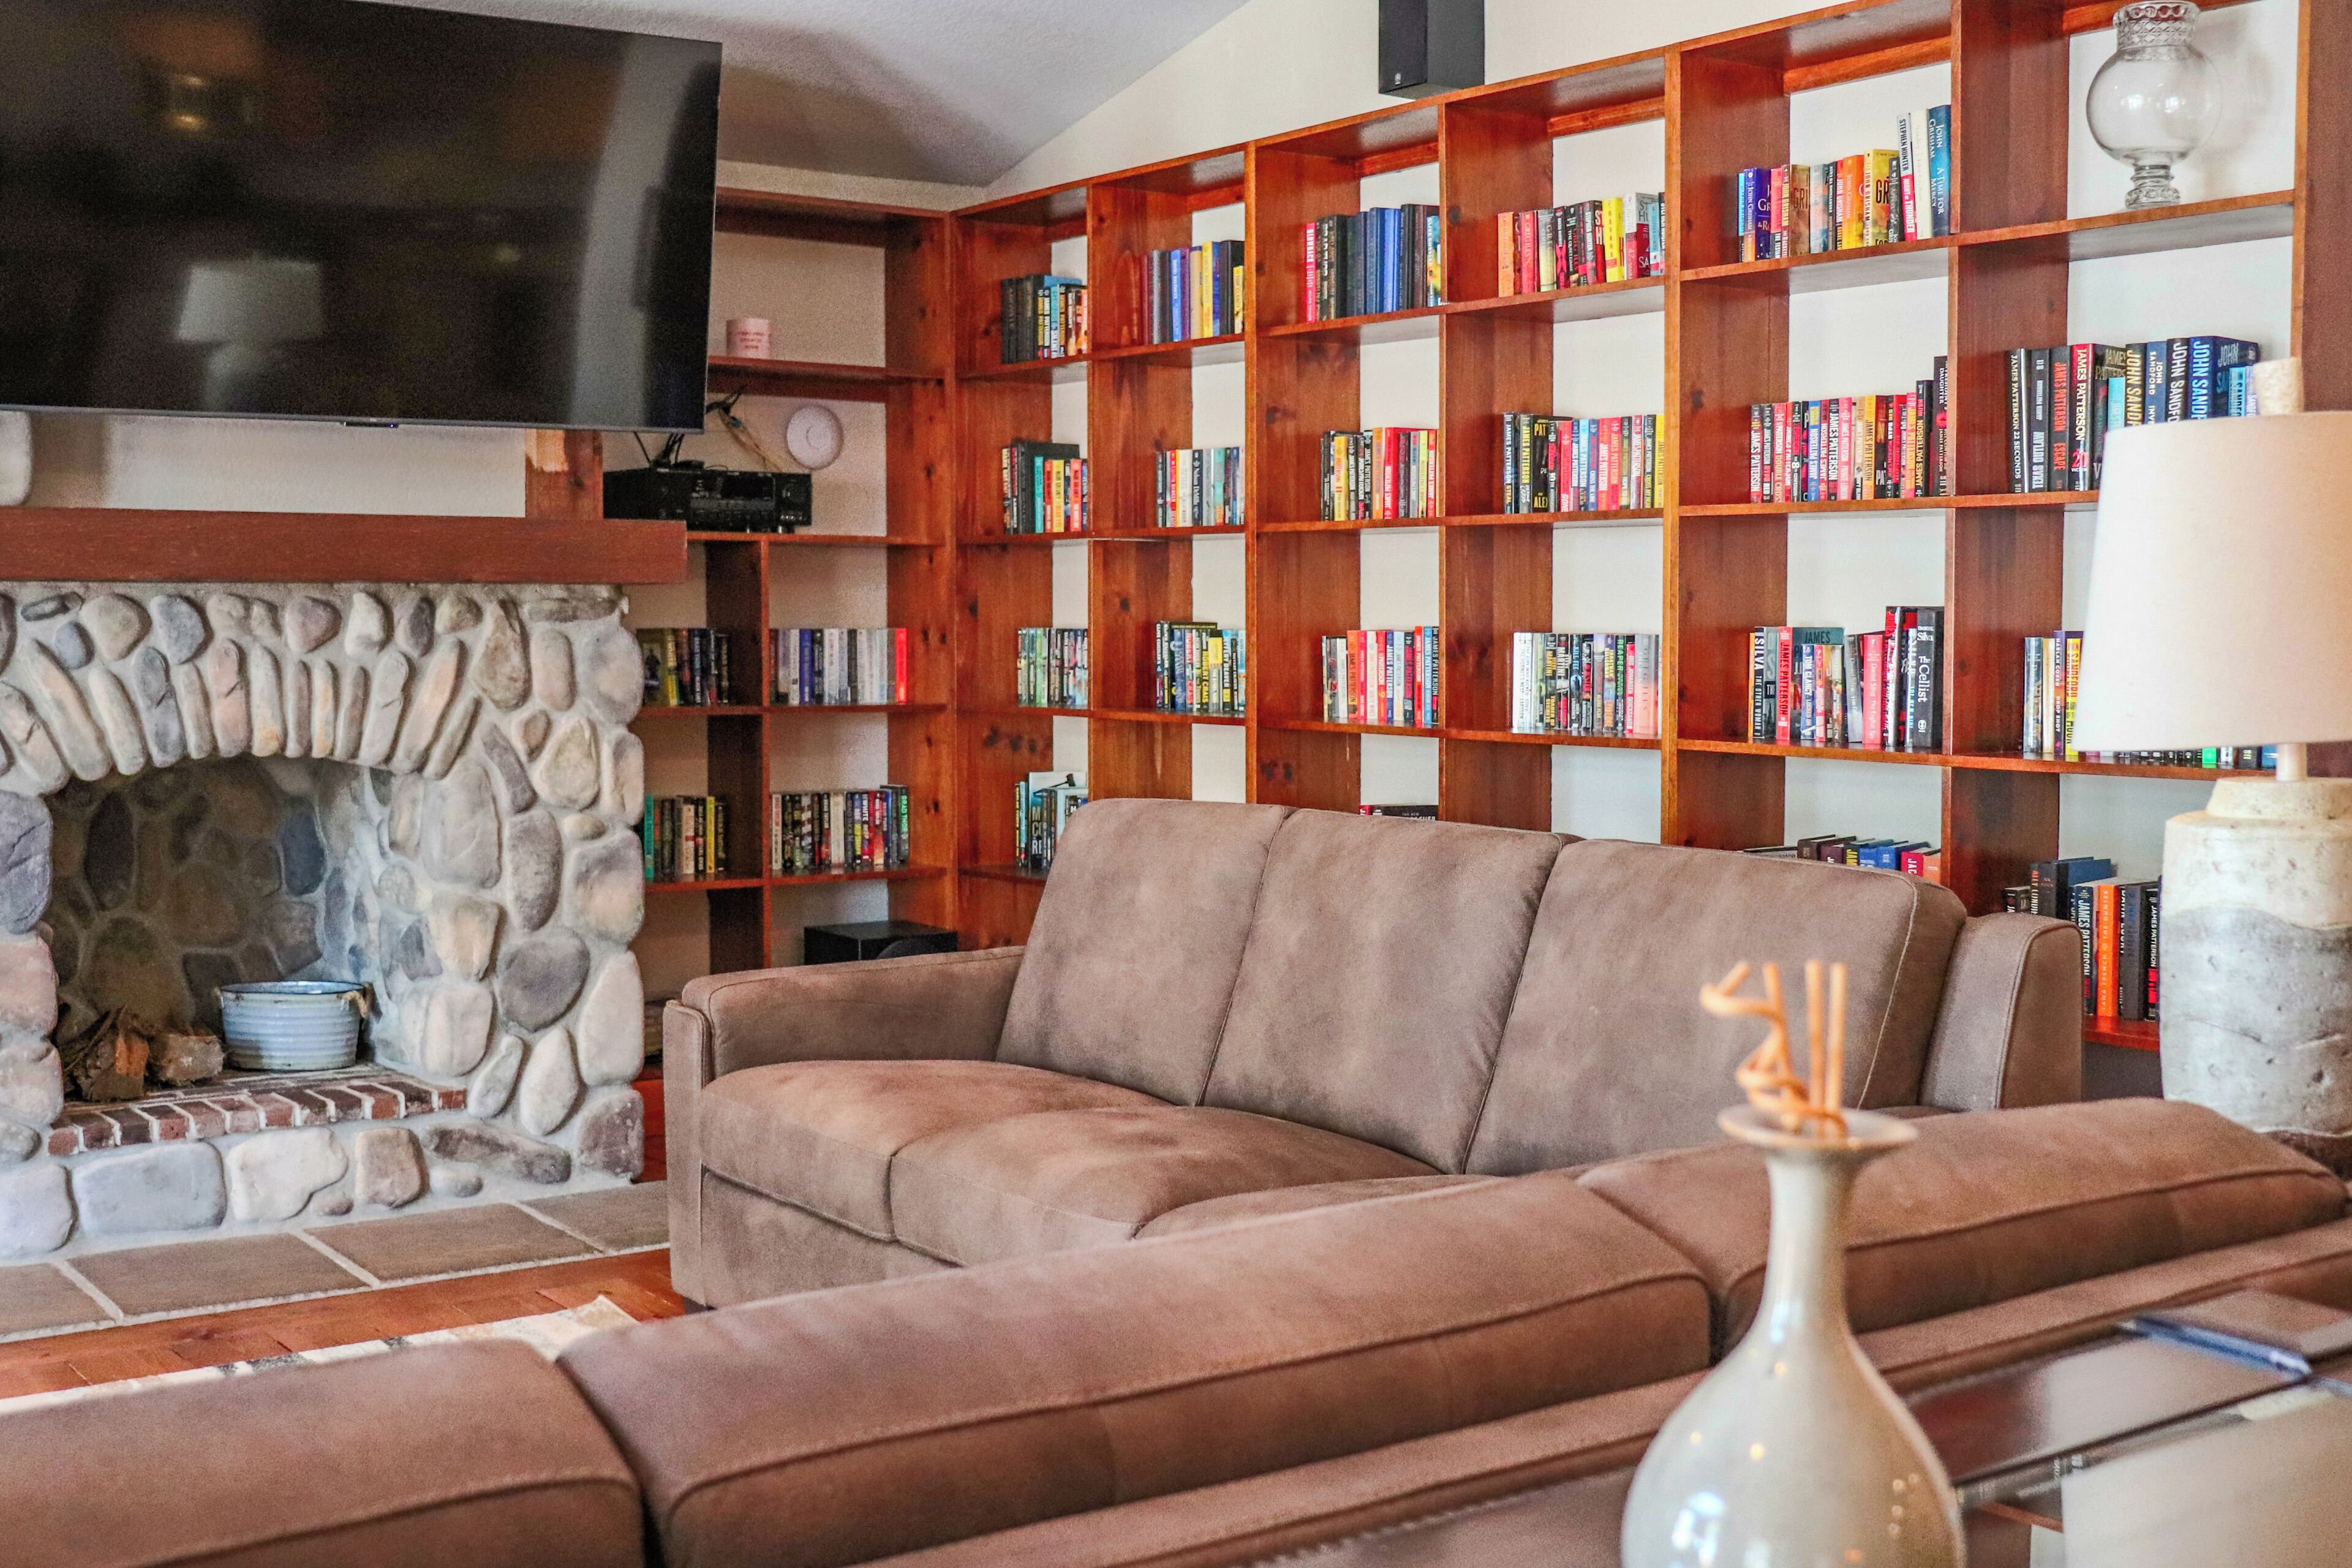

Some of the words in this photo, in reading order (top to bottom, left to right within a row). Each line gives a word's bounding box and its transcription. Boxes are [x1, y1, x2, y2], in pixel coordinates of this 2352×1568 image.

[1905, 200, 1915, 233] THUNDER
[2076, 349, 2087, 381] JAMES
[2126, 350, 2143, 385] JOHN
[2171, 342, 2188, 377] JOHN
[2192, 341, 2210, 377] JOHN
[2053, 362, 2066, 387] JAMES
[1829, 412, 1839, 437] JAMES
[1907, 407, 1916, 430] JAMES
[2053, 389, 2066, 431] PATTERSON
[2075, 382, 2086, 441] PATTERSON
[1751, 430, 1760, 453] JAMES
[1841, 421, 1850, 437] JAMES
[1864, 420, 1874, 442] JAMES
[2013, 431, 2020, 440] 22
[1599, 443, 1608, 461] JAMES
[1809, 429, 1818, 460] PATTERSON
[1828, 438, 1839, 480] PATTERSON
[1907, 431, 1916, 470] PATTERSON
[2032, 431, 2044, 463] OUTLAW
[2053, 442, 2066, 471] ESCAPE
[1599, 462, 1608, 491] PATTERSON
[1751, 455, 1760, 491] PATTERSON
[1809, 461, 1818, 480] JAMES
[1864, 443, 1873, 481] PATTERSON
[2032, 465, 2044, 489] TEXAS
[1804, 631, 1831, 644] JAMES
[1917, 632, 1934, 642] Silva
[1557, 646, 1566, 676] MARTINI
[1754, 638, 1764, 670] SILVA
[1780, 642, 1790, 668] JAMES
[1918, 655, 1931, 664] The
[1804, 671, 1812, 696] CLANCY
[1918, 664, 1930, 703] Cellist
[2066, 653, 2079, 698] SANDFORD
[1779, 671, 1789, 715] PATTERSON
[2078, 899, 2090, 928] JAMES
